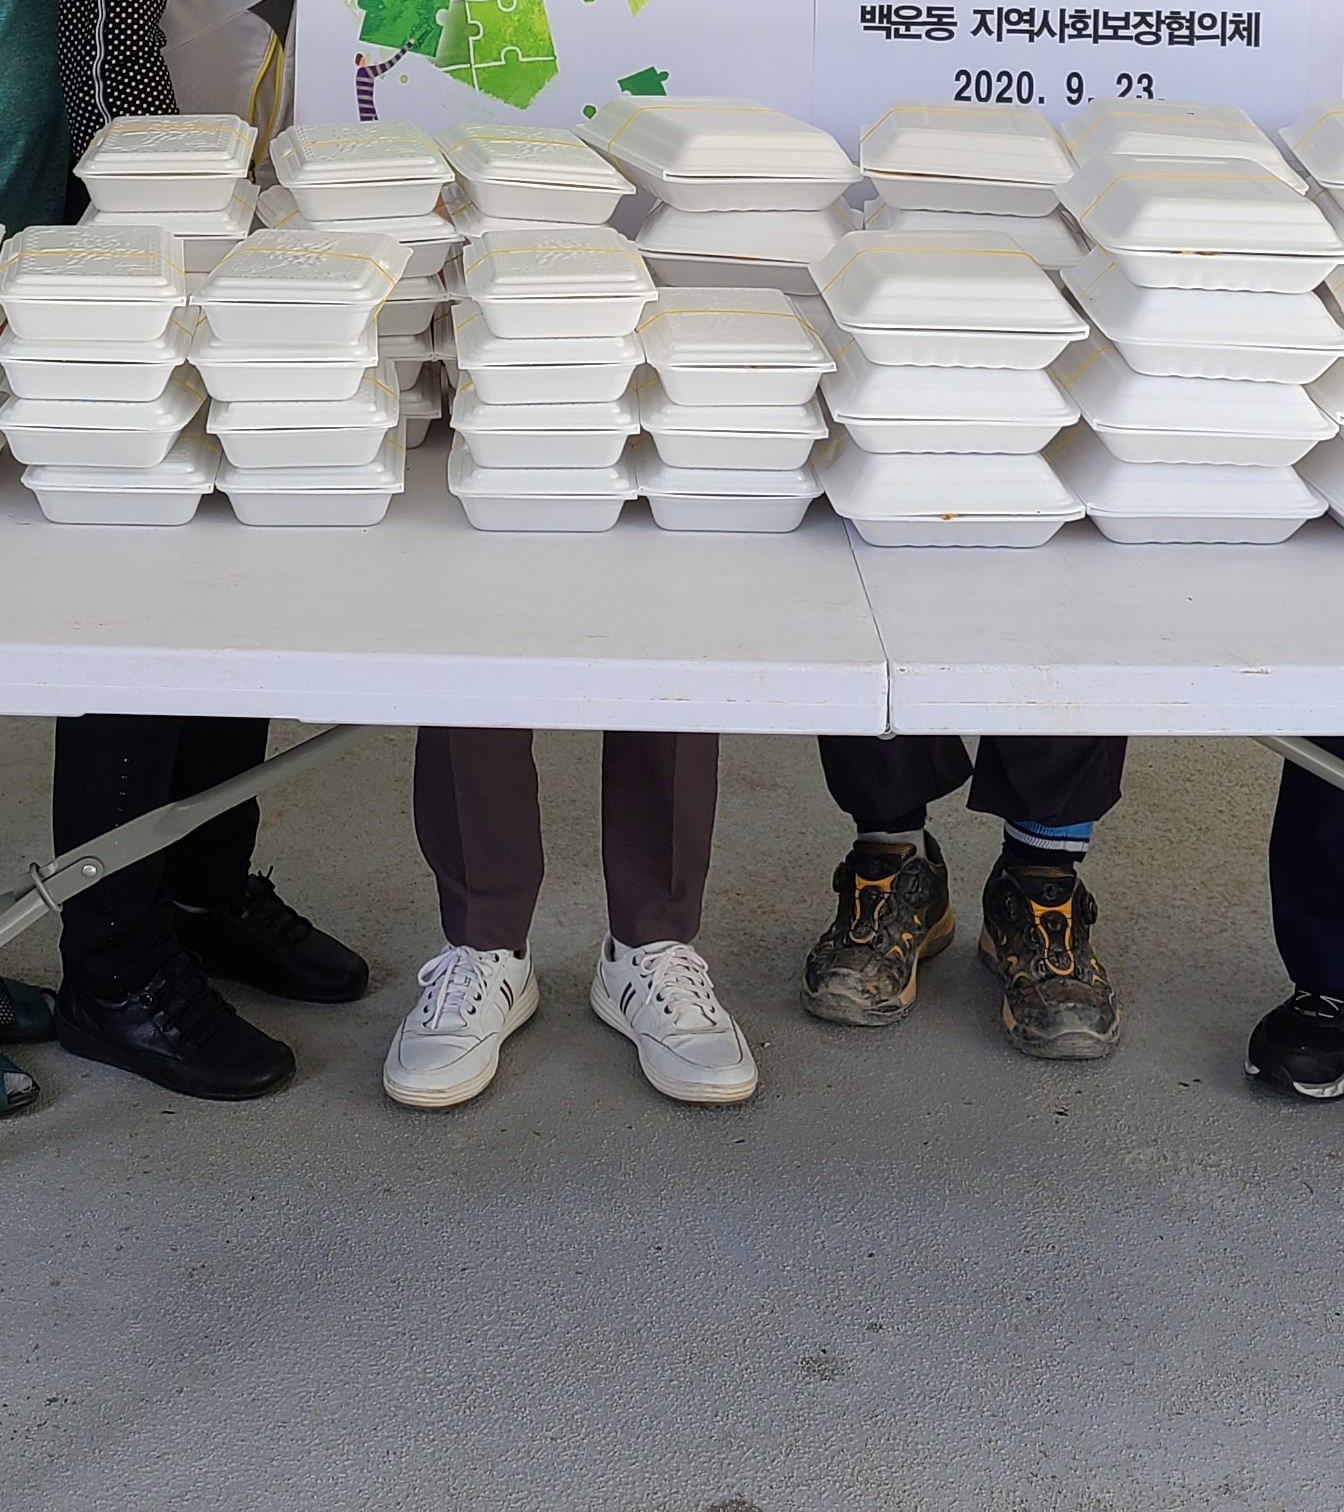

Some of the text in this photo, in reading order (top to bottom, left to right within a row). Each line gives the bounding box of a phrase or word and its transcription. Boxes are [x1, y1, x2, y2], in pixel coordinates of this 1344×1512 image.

[860, 4, 1260, 48] 백운동 지역사회보장협의체
[954, 69, 1045, 104] 2020.
[1116, 72, 1165, 100] 23
